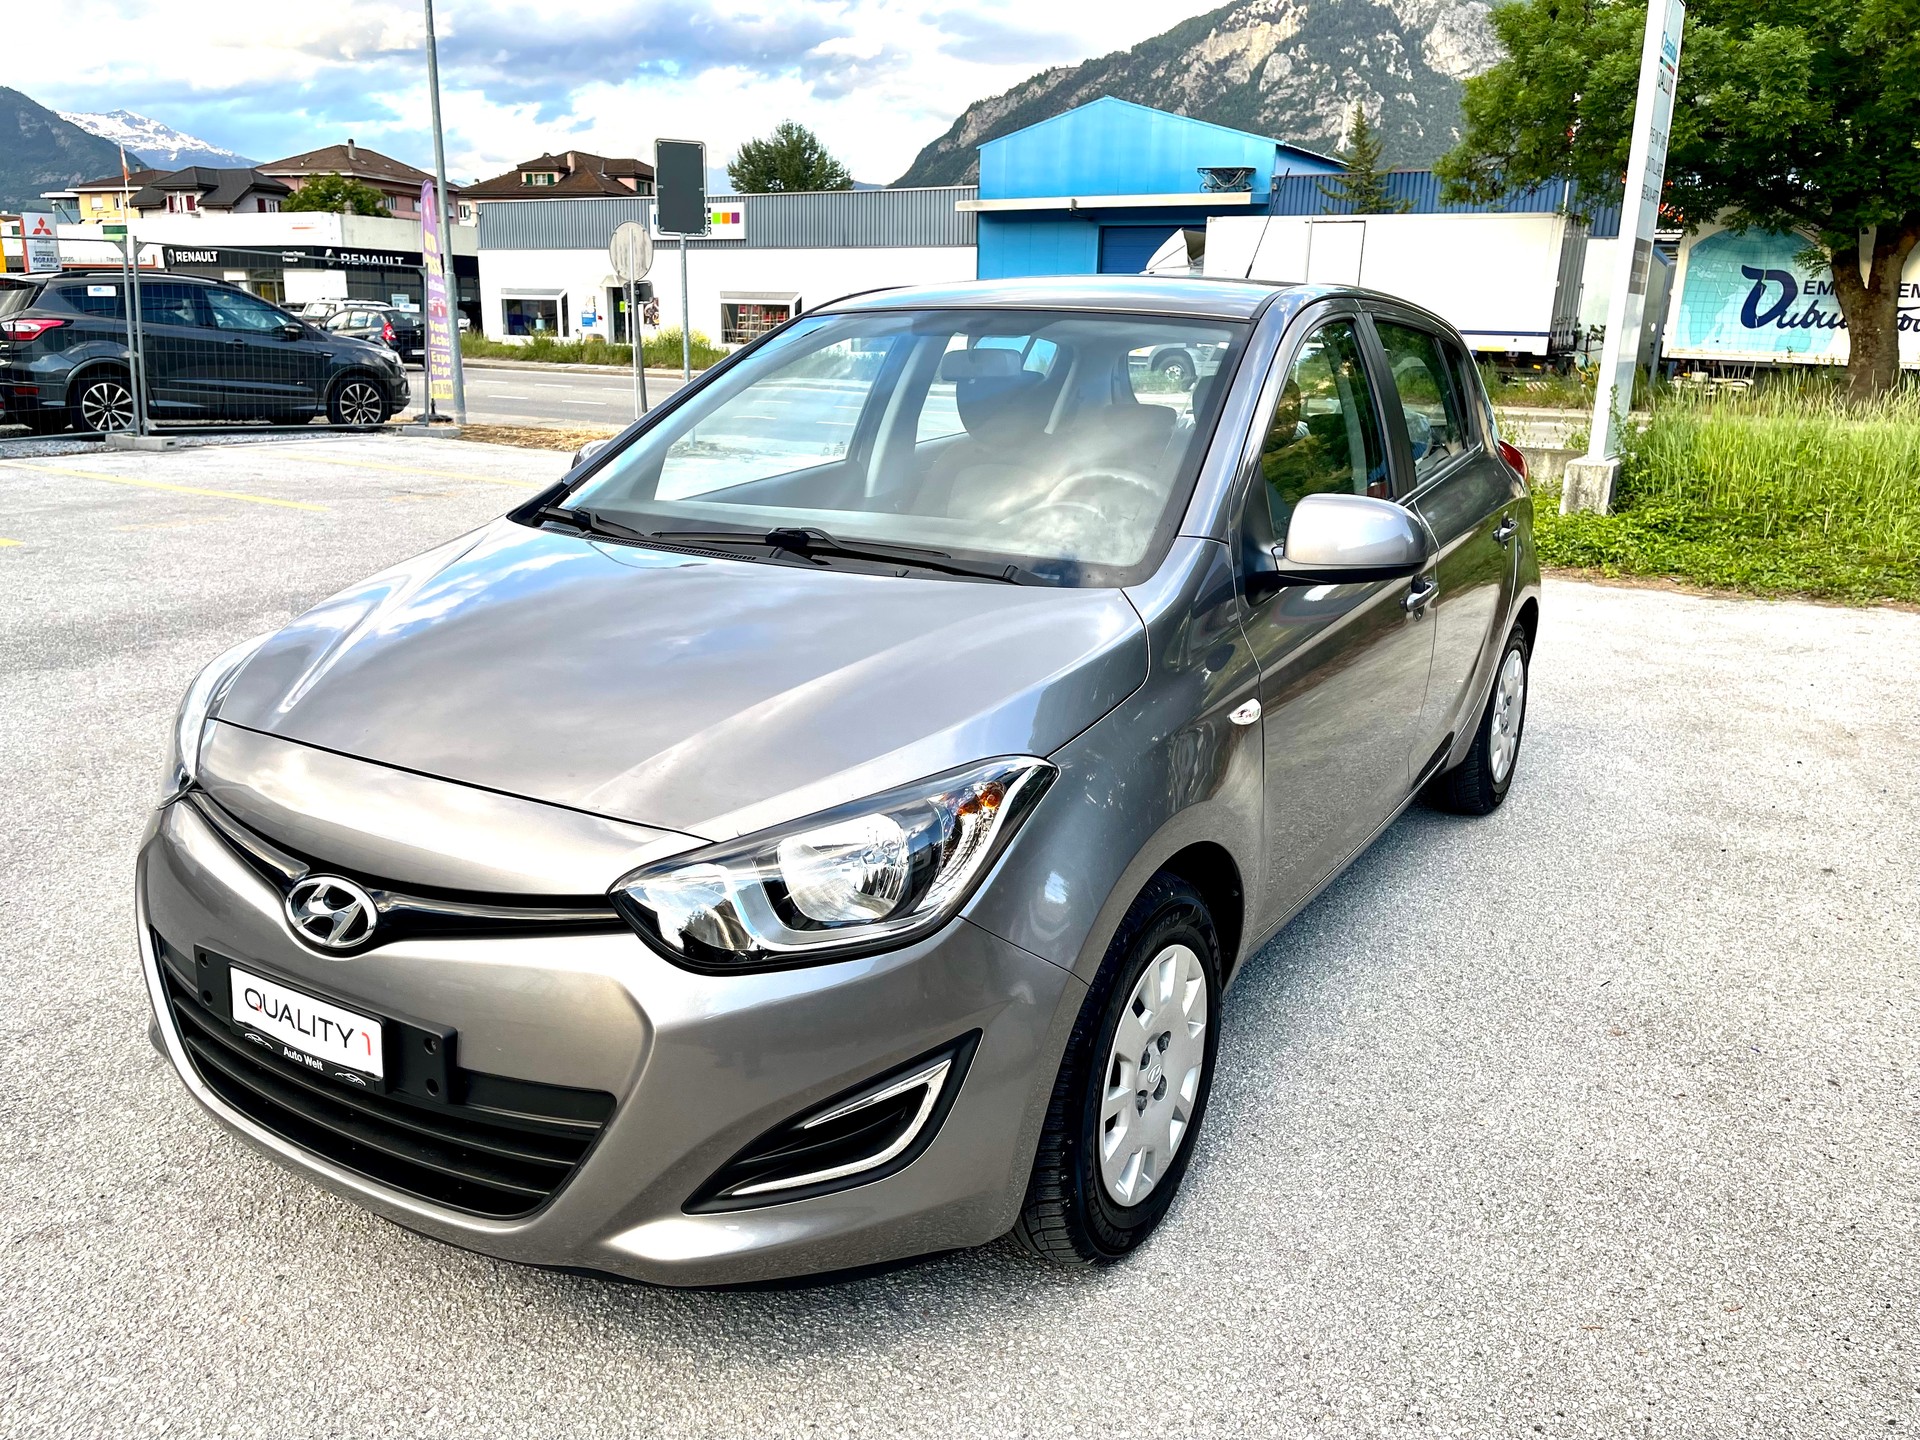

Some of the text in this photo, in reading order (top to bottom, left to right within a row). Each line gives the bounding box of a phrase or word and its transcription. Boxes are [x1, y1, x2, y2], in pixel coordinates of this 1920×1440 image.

[176, 251, 218, 262] RENAULT
[340, 253, 405, 265] RENAULT
[245, 987, 371, 1056] QUALITY 1
[283, 1047, 323, 1071] Auto Welt
